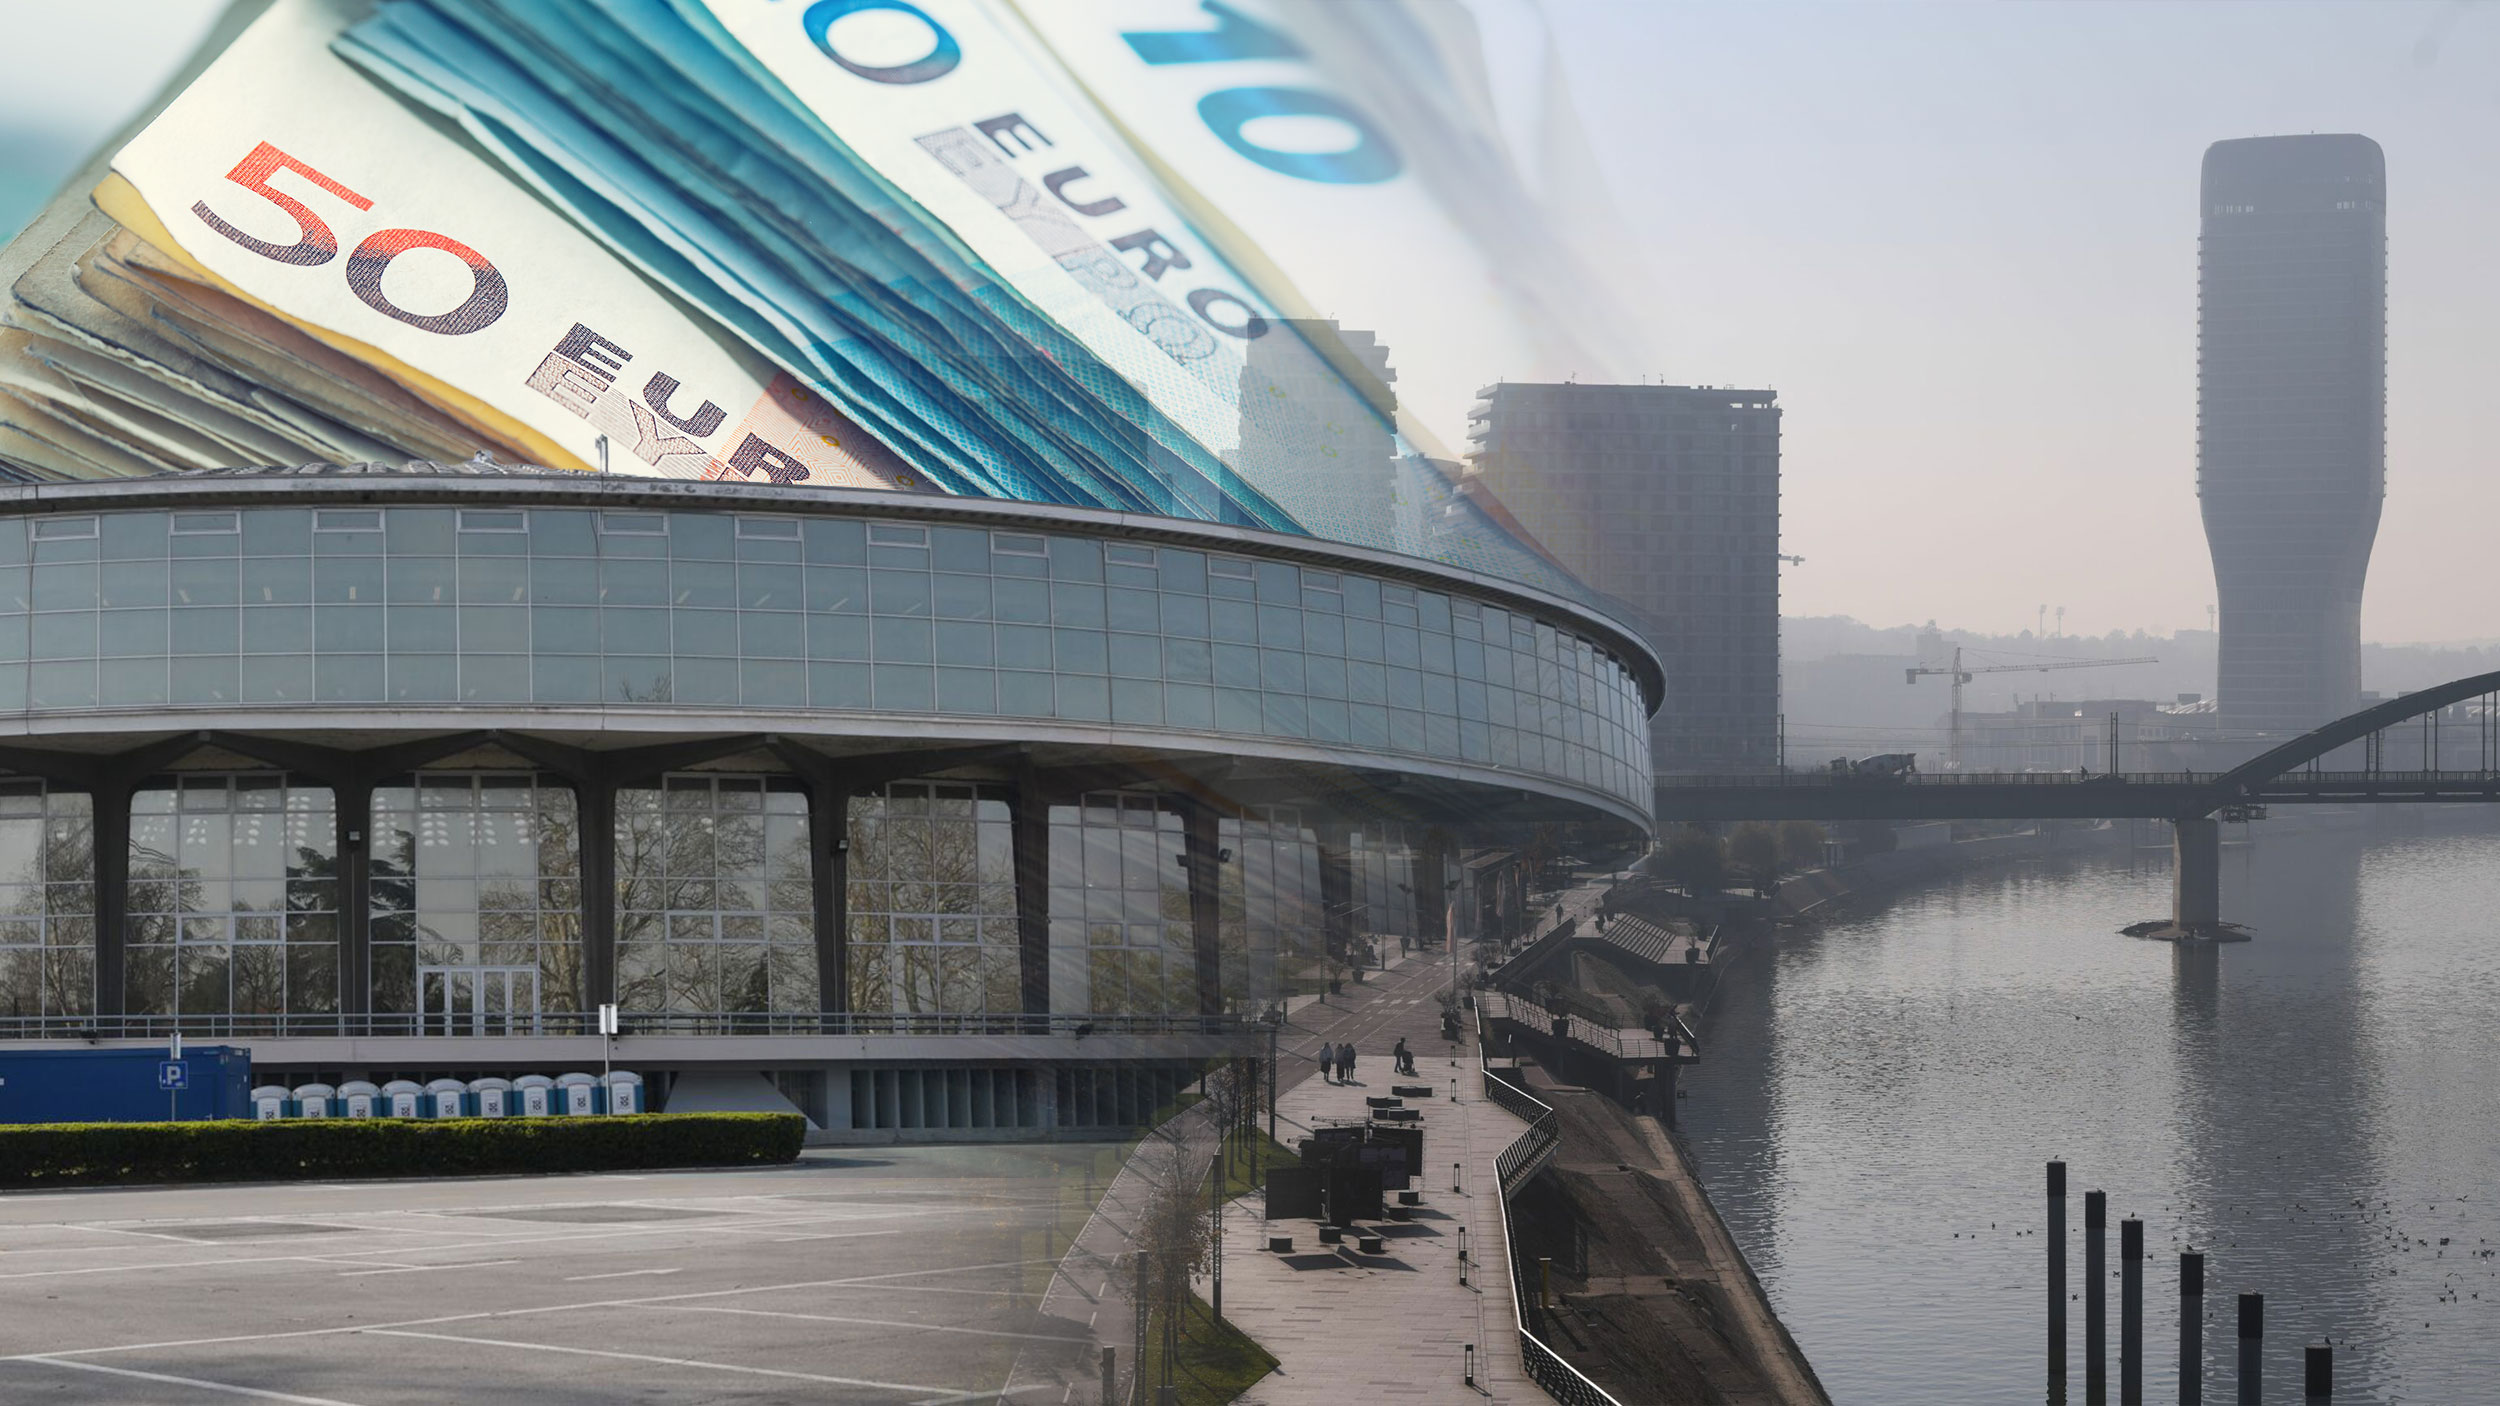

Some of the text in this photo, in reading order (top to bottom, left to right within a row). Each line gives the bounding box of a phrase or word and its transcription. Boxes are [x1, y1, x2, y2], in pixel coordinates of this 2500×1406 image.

[803, 0, 961, 84] 0
[1119, 0, 1405, 184] 10
[191, 140, 508, 336] 50
[972, 112, 1268, 340] EURO
[166, 1066, 181, 1085] P
